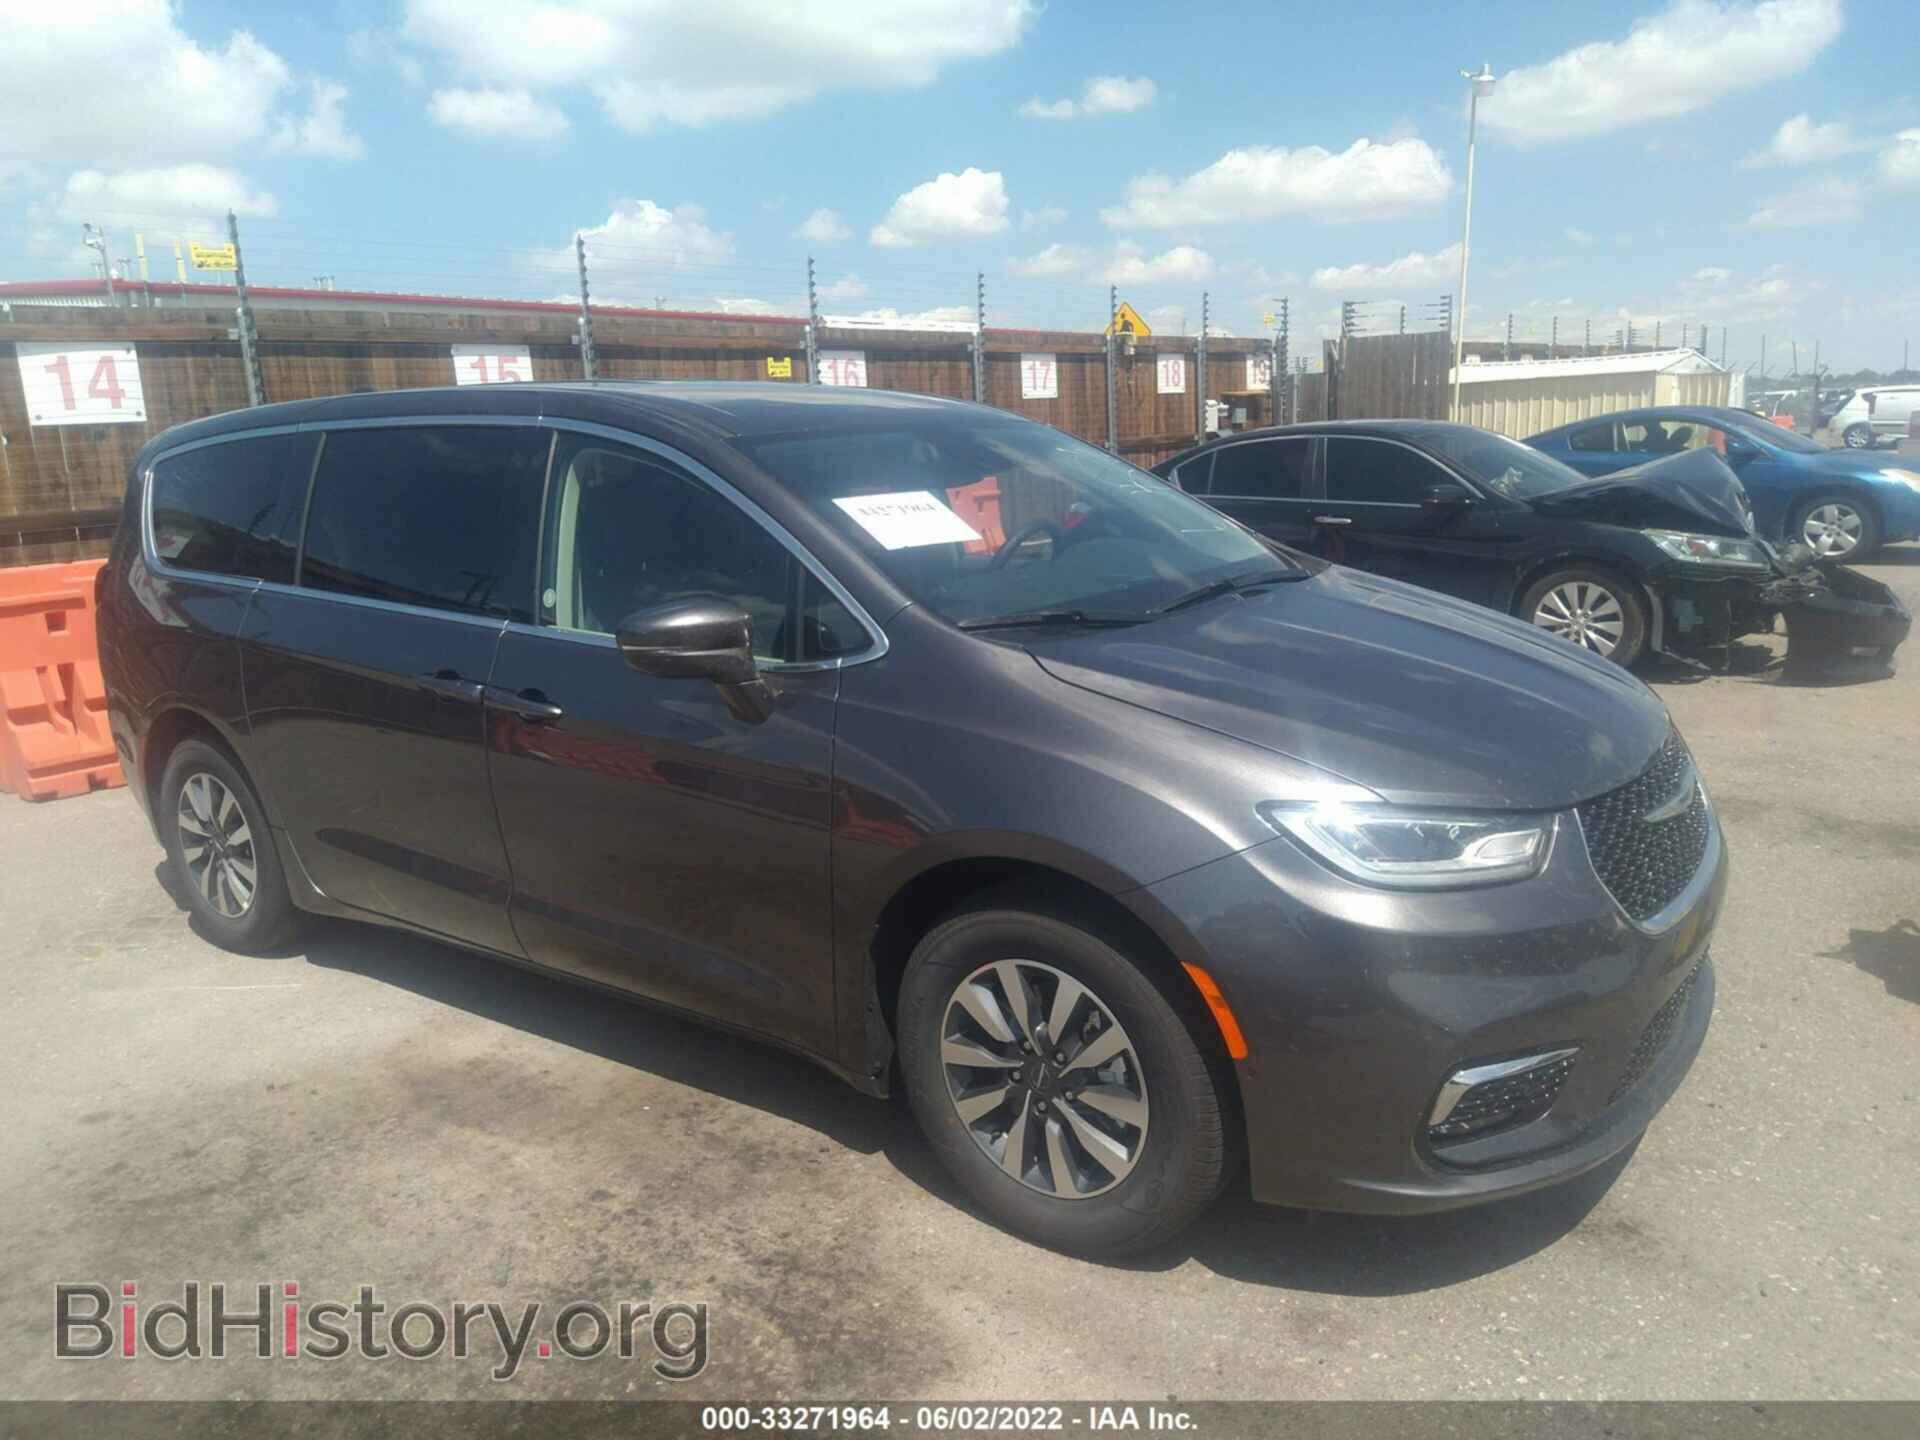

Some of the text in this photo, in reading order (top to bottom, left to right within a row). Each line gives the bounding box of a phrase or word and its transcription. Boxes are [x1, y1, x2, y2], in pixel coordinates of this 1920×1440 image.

[44, 355, 125, 410] 14
[470, 353, 520, 383] 15
[828, 358, 857, 385] 16
[1028, 360, 1051, 390] 17
[1162, 360, 1181, 387] 18
